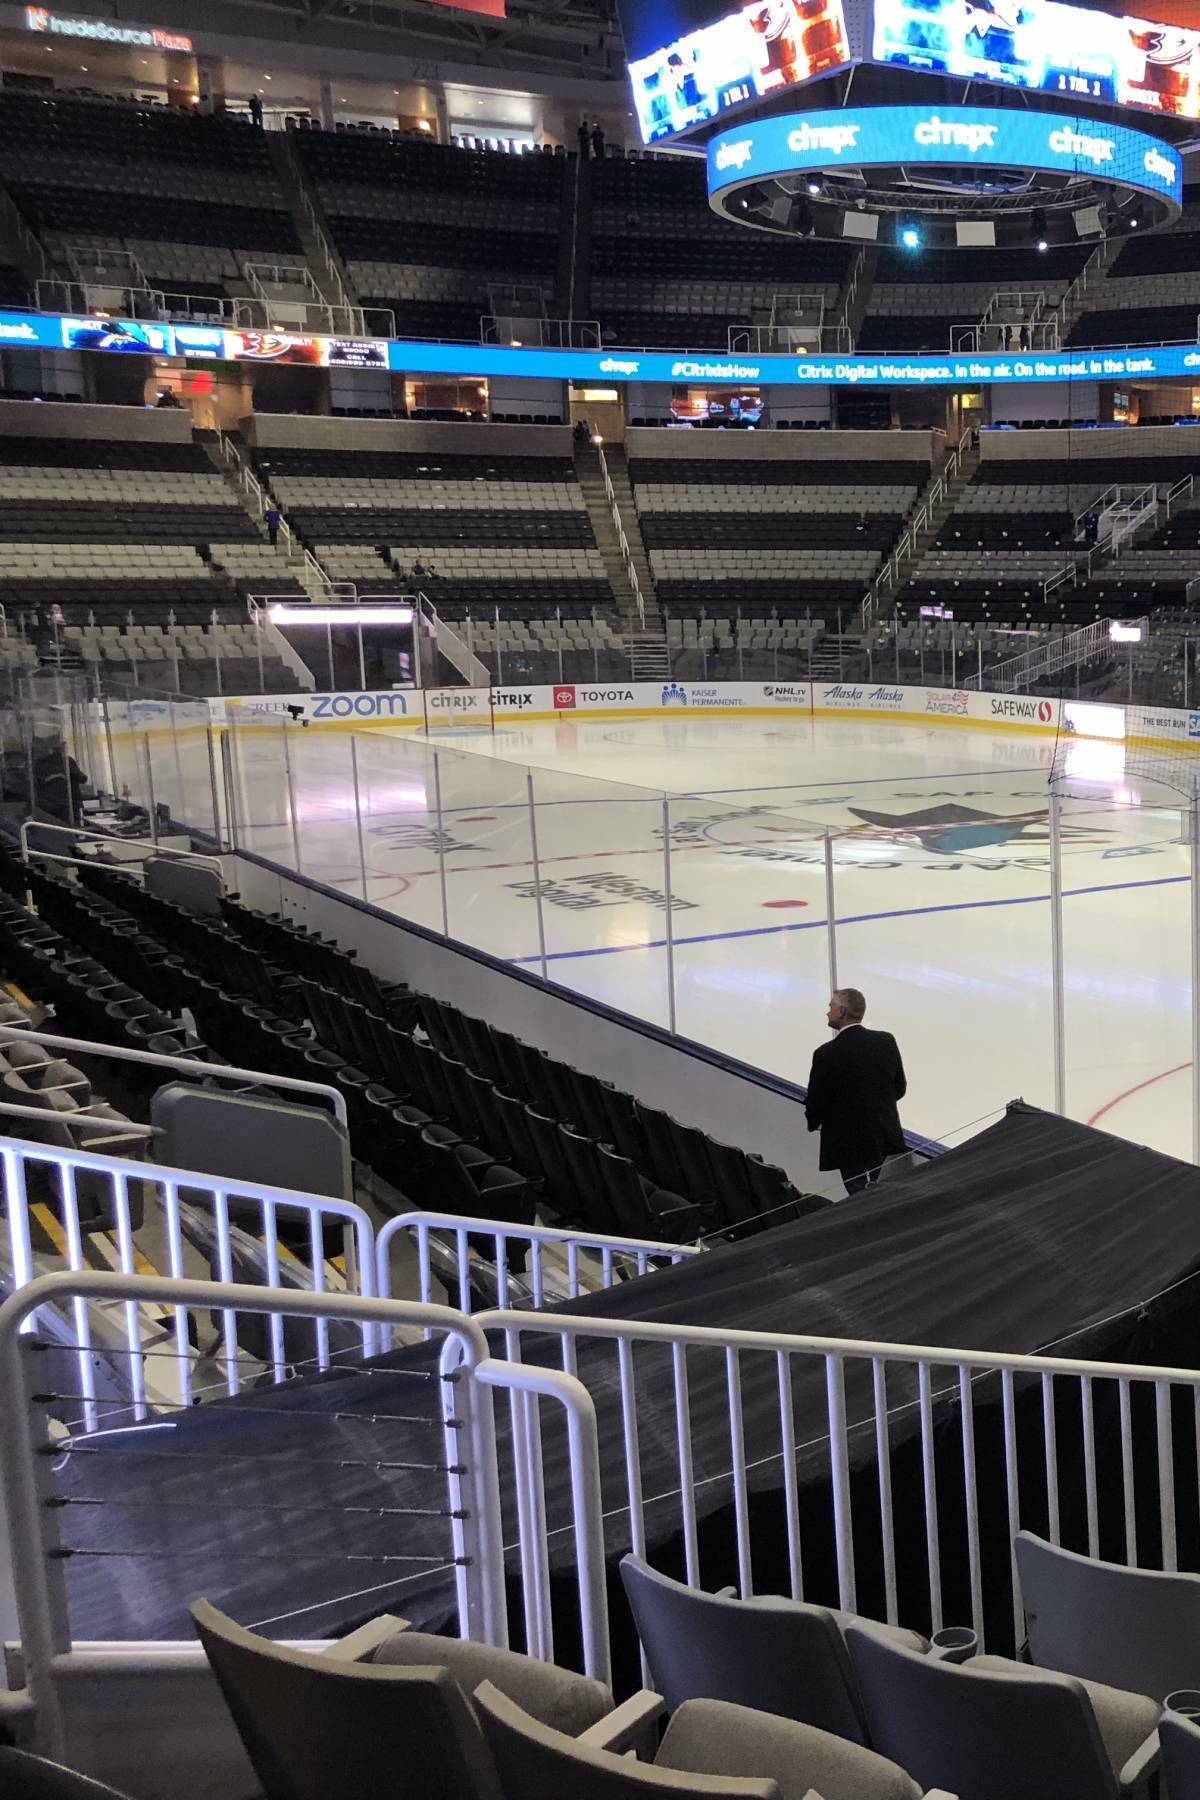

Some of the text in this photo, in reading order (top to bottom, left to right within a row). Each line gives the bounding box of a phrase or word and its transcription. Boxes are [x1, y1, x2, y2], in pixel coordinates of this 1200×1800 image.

[50, 16, 193, 51] InsideSource Plaza
[798, 364, 833, 379] Citrix
[835, 364, 878, 381] Digital
[880, 363, 953, 381] Workspace.
[956, 364, 967, 377] In
[969, 364, 991, 377] the
[1013, 362, 1033, 376] On
[1035, 362, 1056, 376] the
[1059, 361, 1087, 375] road.
[1090, 361, 1102, 374] In
[1103, 360, 1124, 373] the
[1126, 358, 1156, 372] tank.
[580, 690, 634, 702] TOYOTA
[692, 689, 717, 697] KAISER
[775, 687, 806, 695] NHL.TV
[824, 685, 863, 700] Alaska
[868, 687, 903, 702] Alaska
[311, 693, 406, 718] zoom
[692, 698, 743, 706] PERMANENTE
[926, 702, 968, 715] AMERICA
[992, 699, 1038, 718] SAFEWAY
[1143, 717, 1155, 725] THE
[1156, 718, 1171, 727] BEST
[1172, 720, 1186, 729] RUN
[502, 878, 632, 911] Digital
[561, 871, 701, 911] Western
